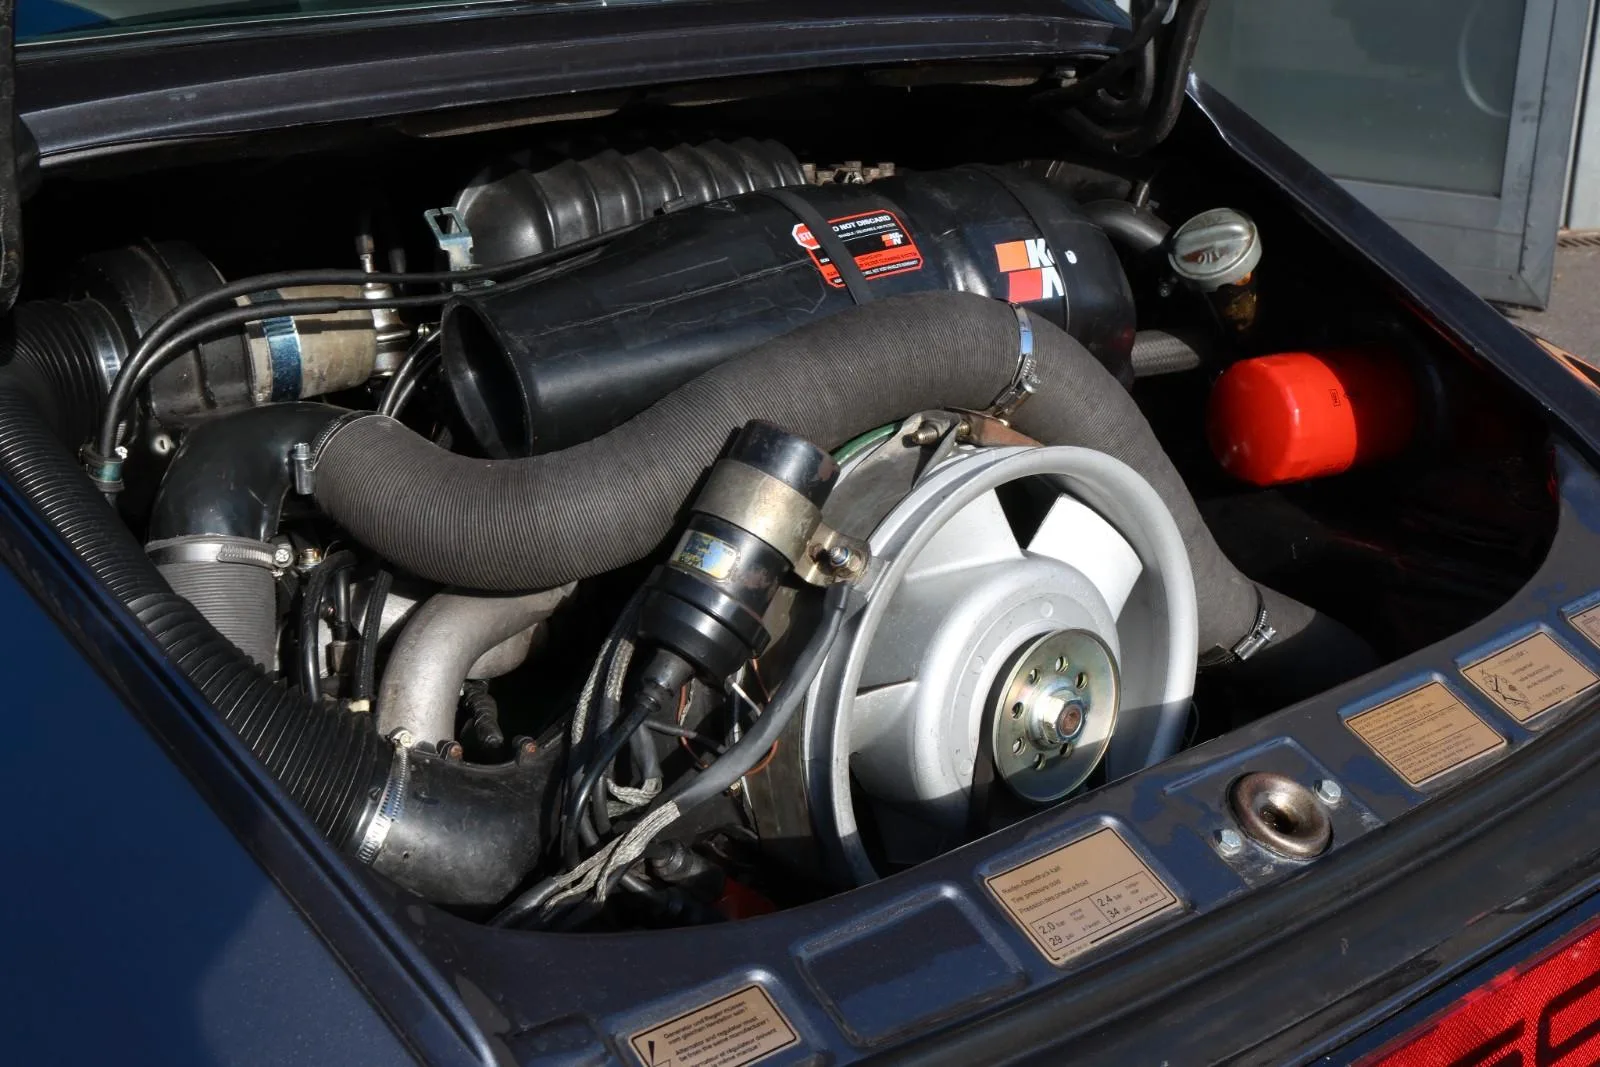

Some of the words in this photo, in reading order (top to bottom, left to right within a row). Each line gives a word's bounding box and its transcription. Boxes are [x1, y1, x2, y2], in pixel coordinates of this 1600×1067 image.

[839, 222, 855, 230] NOT
[857, 216, 890, 226] DISCARD
[1107, 908, 1120, 918] 34
[664, 1025, 692, 1038] Generator
[676, 1041, 704, 1055] Alternator
[705, 1034, 716, 1042] and
[717, 1024, 741, 1036] regulator
